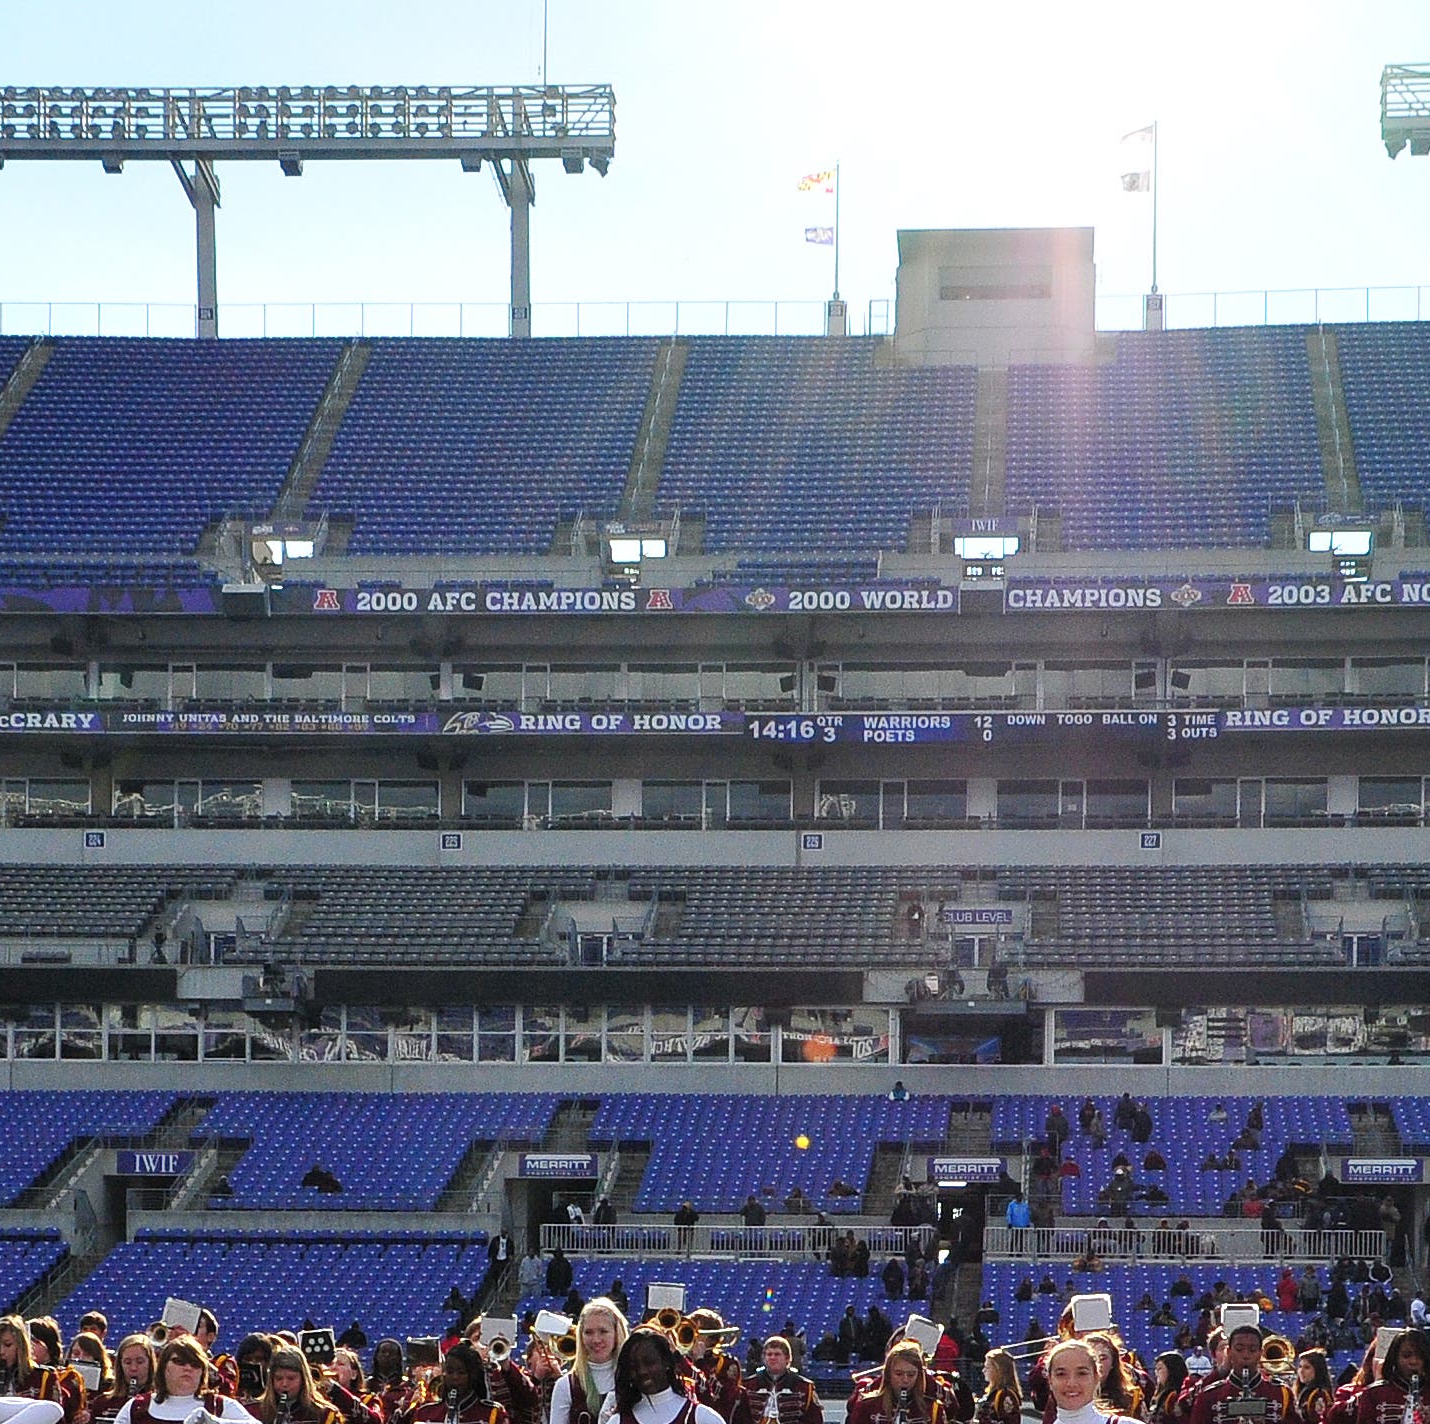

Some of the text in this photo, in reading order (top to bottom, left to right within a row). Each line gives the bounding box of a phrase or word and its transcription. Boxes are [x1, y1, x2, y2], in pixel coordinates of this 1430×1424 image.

[972, 520, 999, 531] IWIF
[788, 591, 850, 610] 2000
[861, 590, 953, 609] WORLD
[1008, 588, 1161, 608] CHAMPIONS
[1268, 585, 1330, 604] 2003
[1340, 584, 1392, 603] AFC
[357, 592, 417, 611] 2000
[428, 592, 476, 611] AFC
[486, 591, 635, 610] CHAMPIONS
[122, 713, 416, 724] JOHNNY UNITAS AND THE BALTIMORE COLTS
[520, 714, 721, 730] RING OF HONOR
[818, 716, 843, 727] QTR
[864, 716, 992, 729] WARRIORS 12
[1007, 714, 1046, 725] DOWN
[1102, 714, 1135, 725] BALL
[1139, 714, 1157, 724] ON
[1167, 714, 1215, 726] 3 TIME
[1226, 710, 1290, 726] RING
[1300, 709, 1333, 725] OF
[749, 721, 814, 738] 14:16
[823, 727, 836, 742] 3
[1167, 728, 1217, 740] 3 OUTS
[864, 730, 992, 742] POETS 0
[976, 912, 1009, 922] LEVEL
[135, 1155, 179, 1172] IWIF
[527, 1161, 590, 1169] MERRITT
[935, 1165, 999, 1173] MERRITT
[1349, 1166, 1415, 1174] MERRITT
